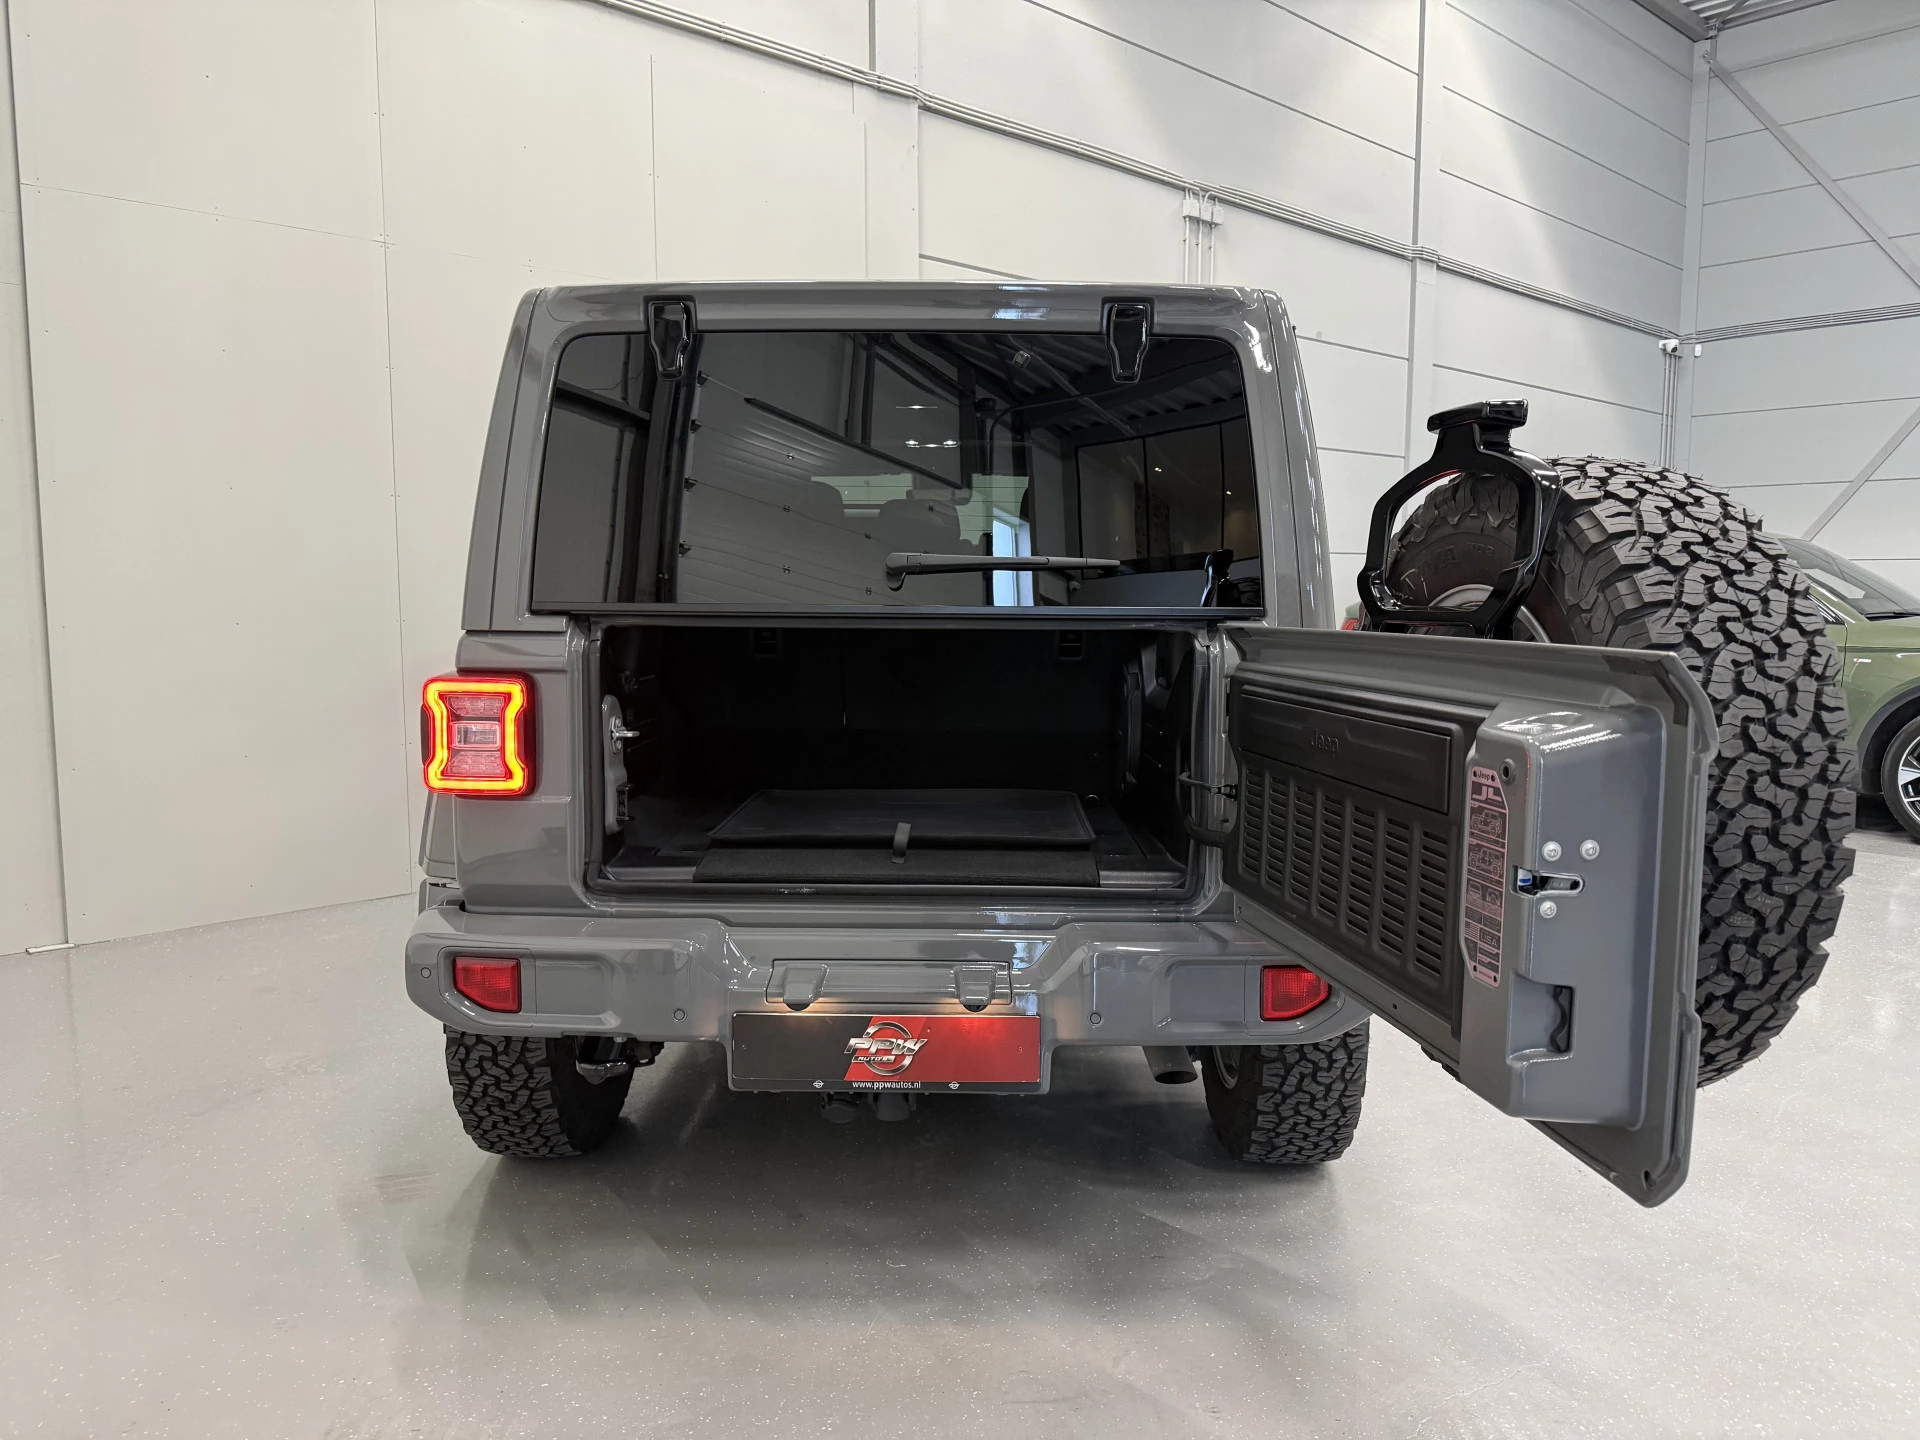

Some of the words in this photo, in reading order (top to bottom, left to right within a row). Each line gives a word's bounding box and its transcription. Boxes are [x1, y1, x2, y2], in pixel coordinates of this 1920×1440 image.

[1310, 728, 1339, 760] Jeep
[1478, 771, 1490, 781] Jeep
[1480, 932, 1498, 948] USA
[844, 1037, 928, 1055] PPW
[852, 1081, 921, 1090] www.ppwautos.nl
